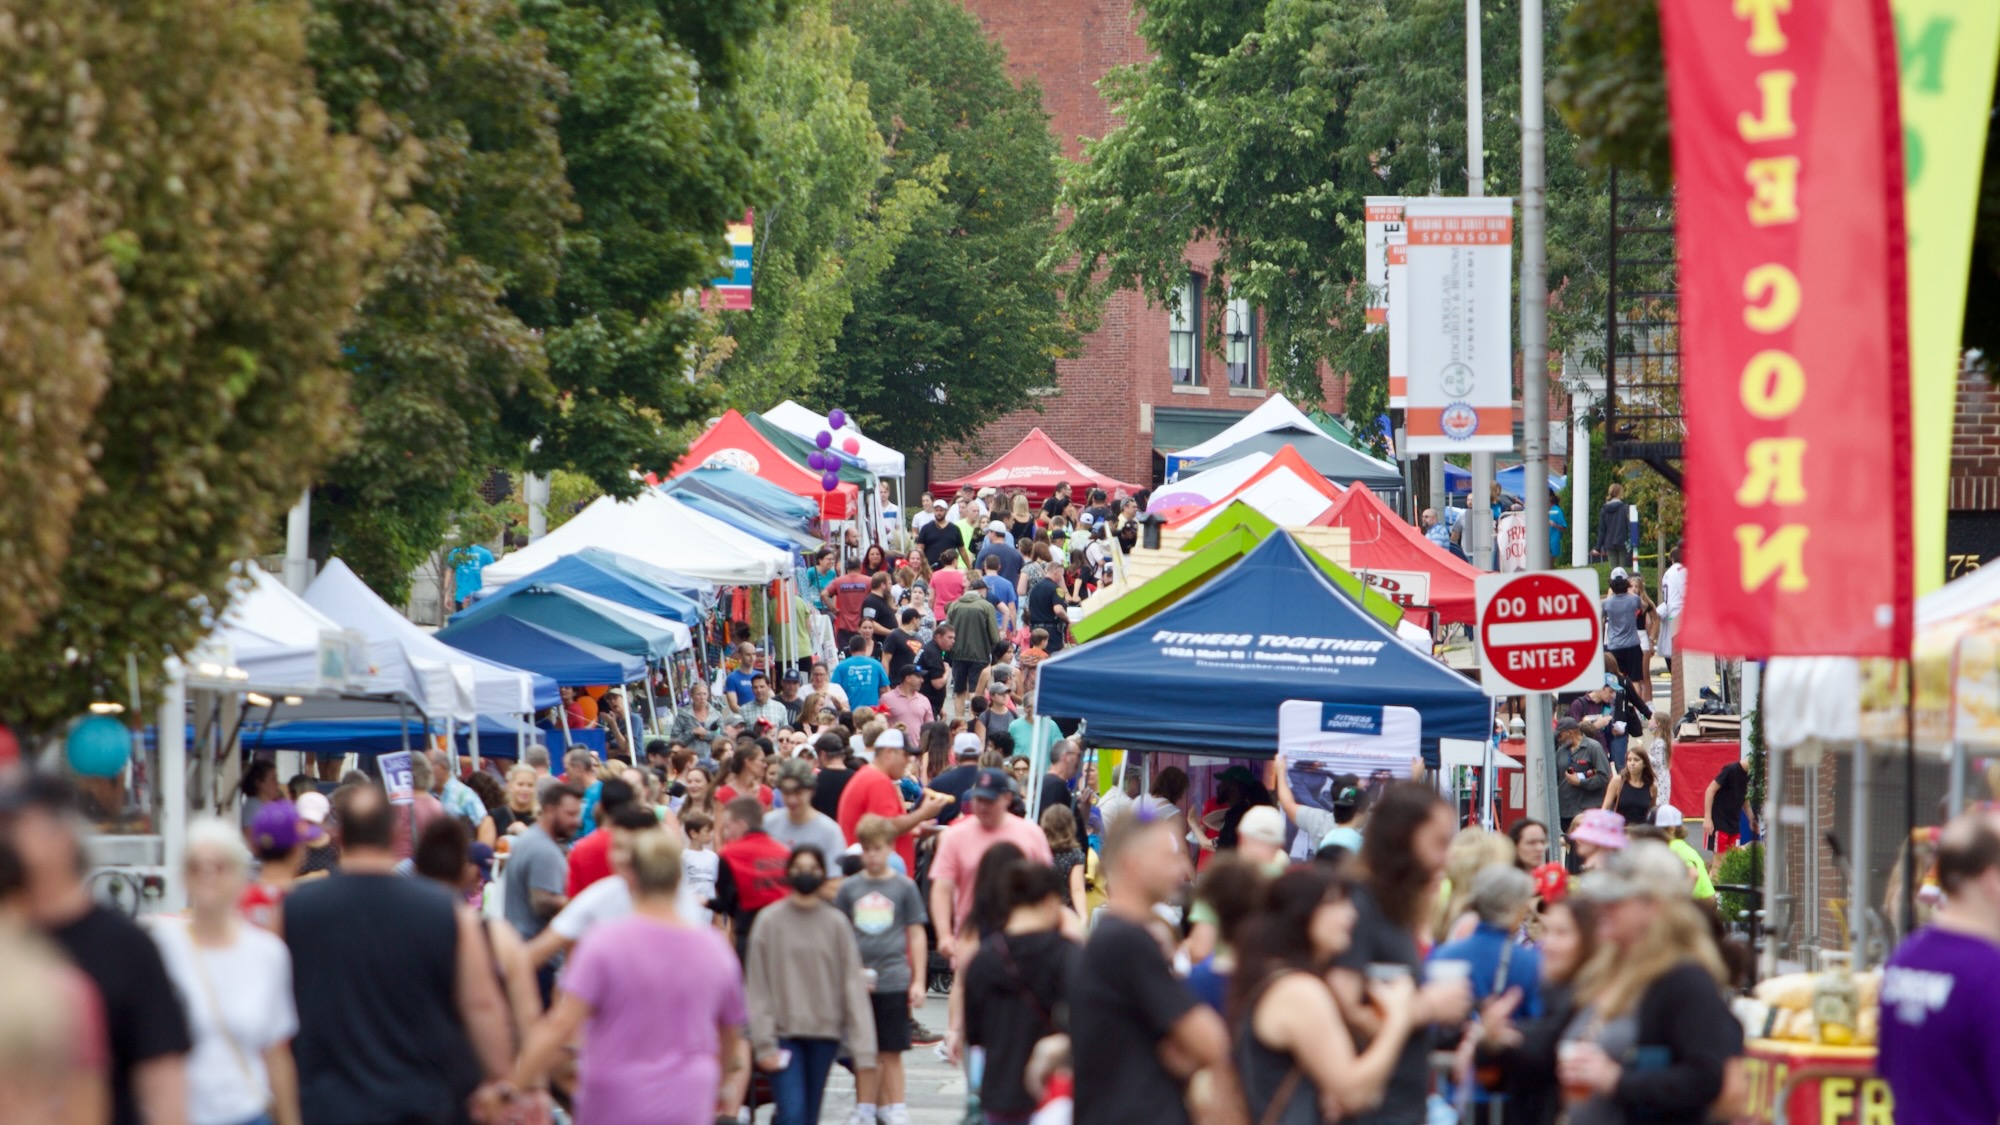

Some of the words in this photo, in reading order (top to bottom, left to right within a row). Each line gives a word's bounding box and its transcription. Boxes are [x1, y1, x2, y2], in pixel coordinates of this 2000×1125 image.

[1422, 232, 1499, 242] SPONSOR
[1949, 554, 1981, 579] 75
[1496, 597, 1526, 618] DO
[1537, 594, 1580, 615] NOT
[1151, 631, 1253, 646] FITNESS
[1257, 634, 1385, 652] TOGETHER
[1195, 648, 1229, 659] Main
[1230, 650, 1245, 659] St
[1311, 654, 1334, 664] MA
[1507, 647, 1576, 671] ENTER
[1327, 719, 1375, 729] TOGETHER
[1333, 713, 1373, 722] FITNESS
